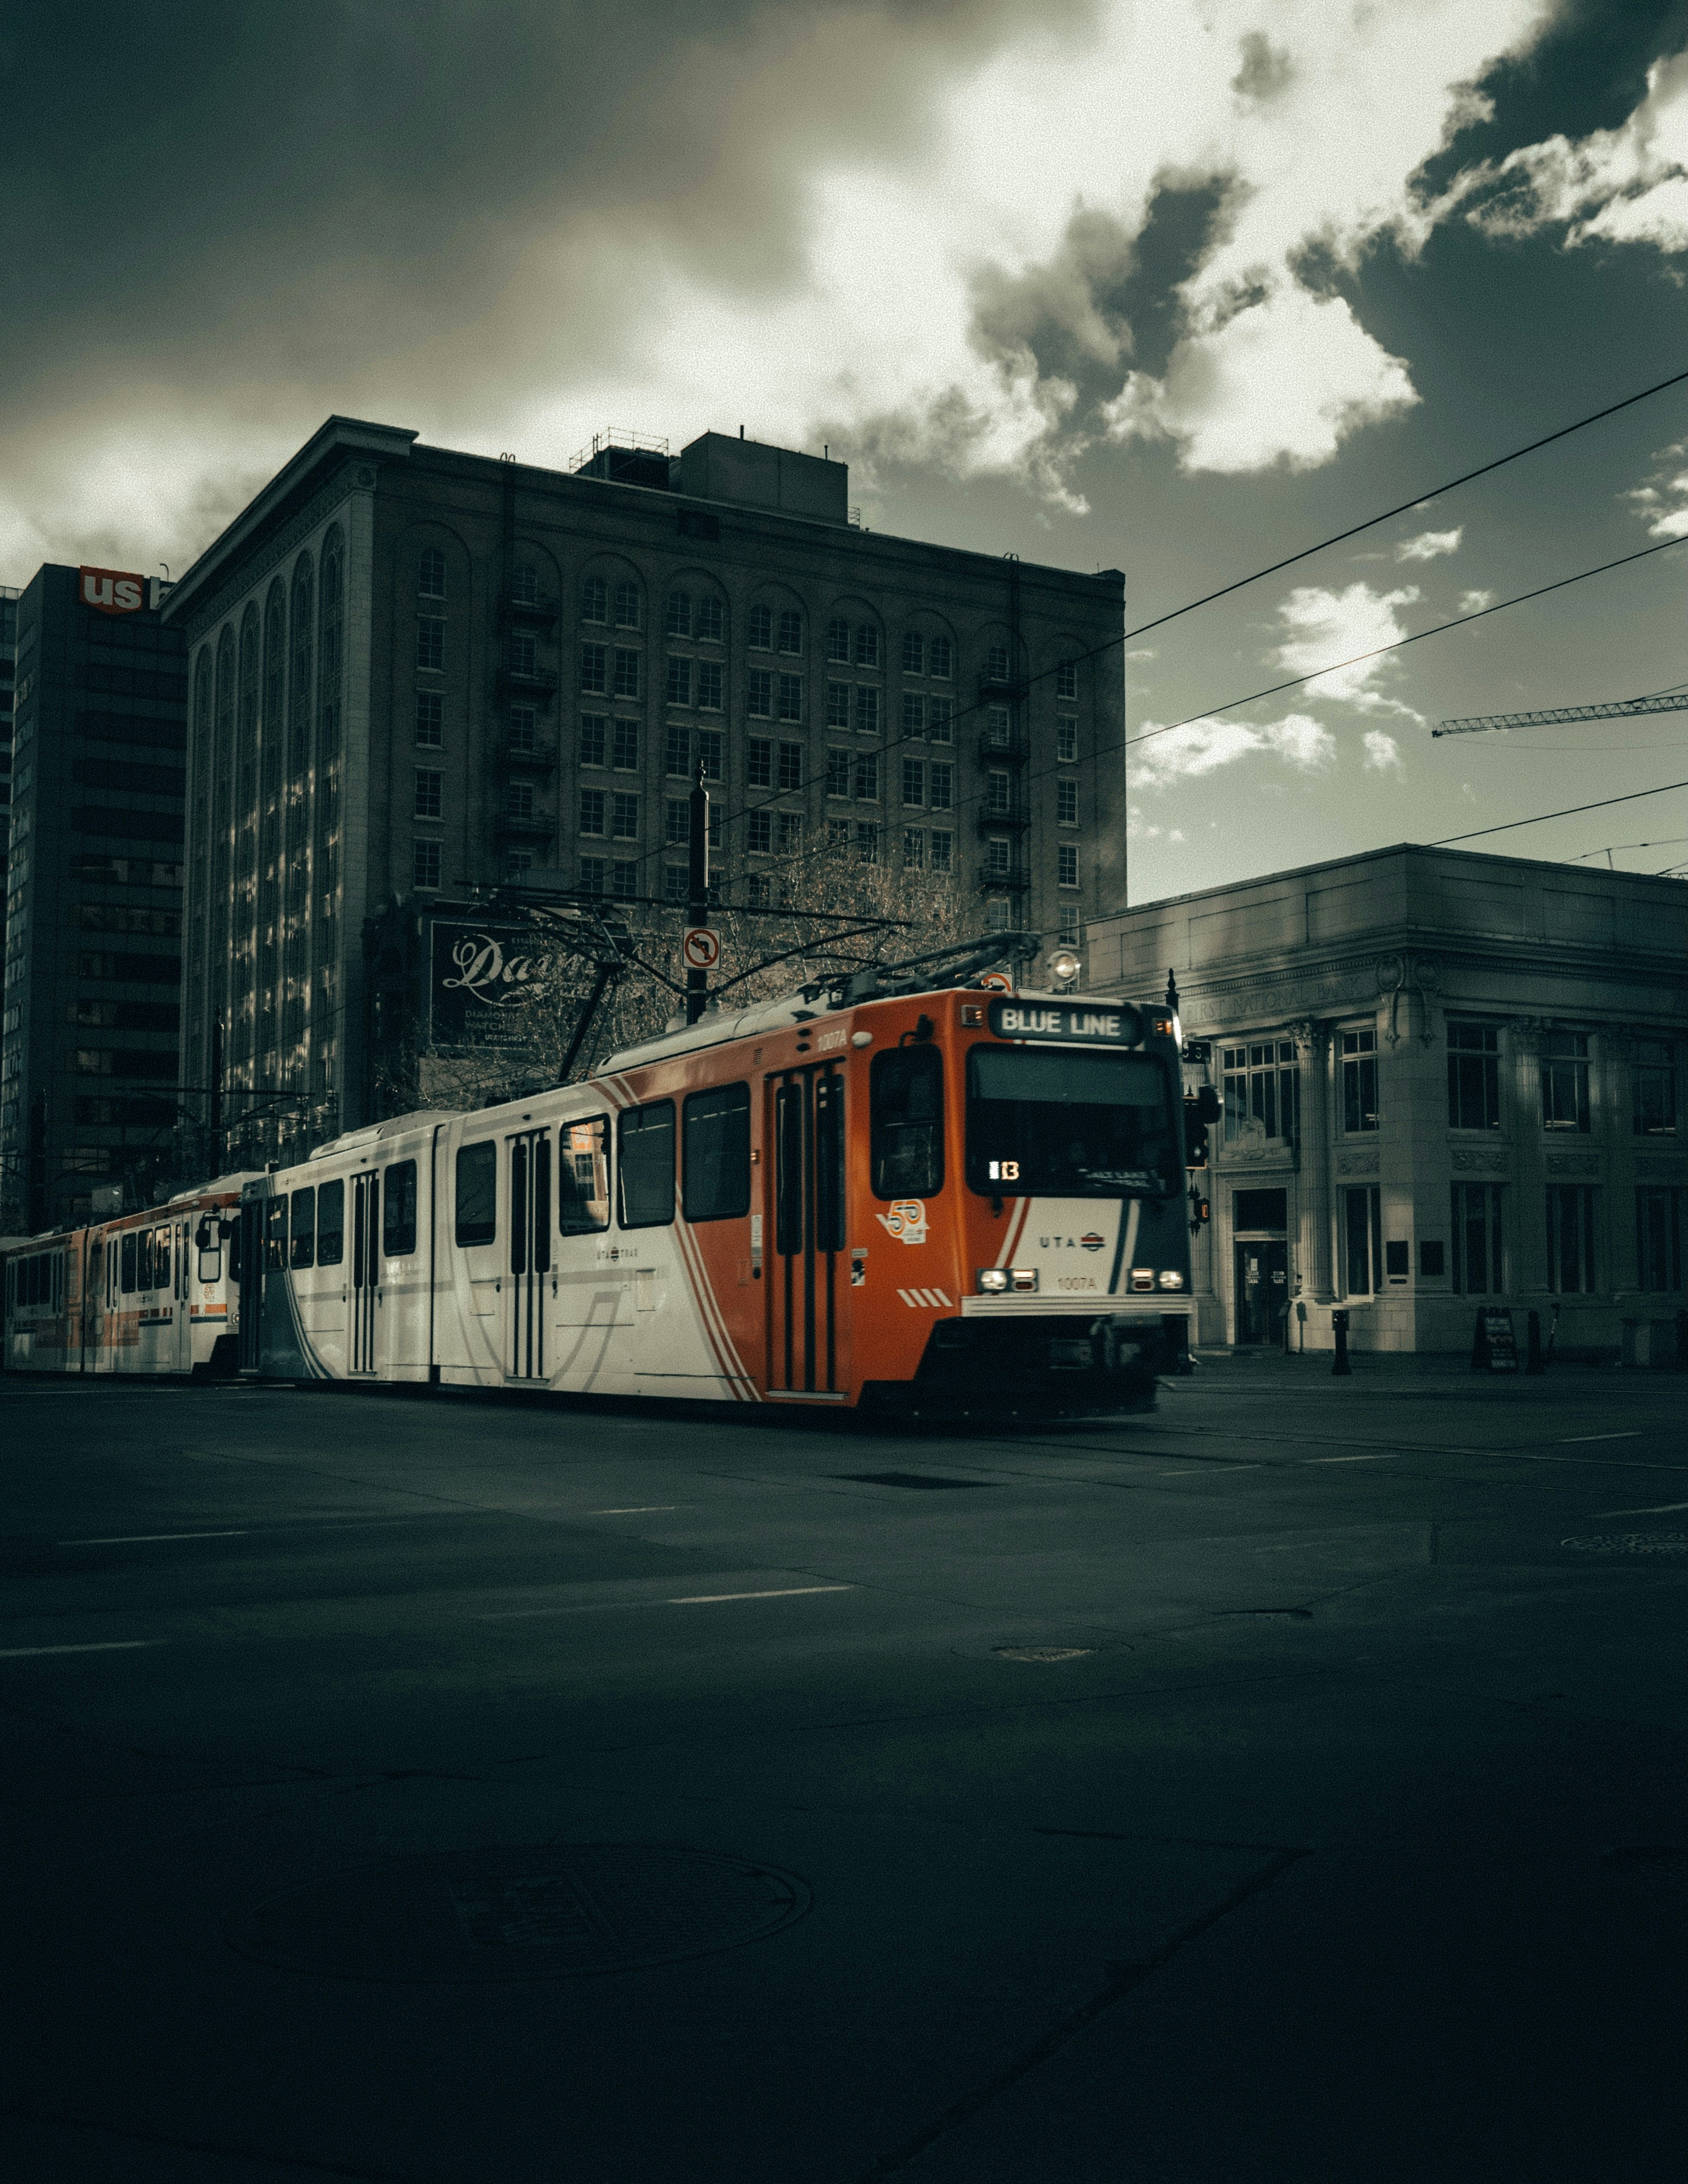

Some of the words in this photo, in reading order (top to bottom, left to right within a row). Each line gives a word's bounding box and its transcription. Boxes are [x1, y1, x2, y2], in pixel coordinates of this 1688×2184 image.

[1187, 999, 1225, 1022] FIRST
[1233, 984, 1307, 1014] NATIONAL
[1002, 1008, 1062, 1033] BLUE
[1070, 1012, 1121, 1036] LINE
[1039, 1237, 1075, 1248] UTA
[1058, 1278, 1097, 1290] 1007A
